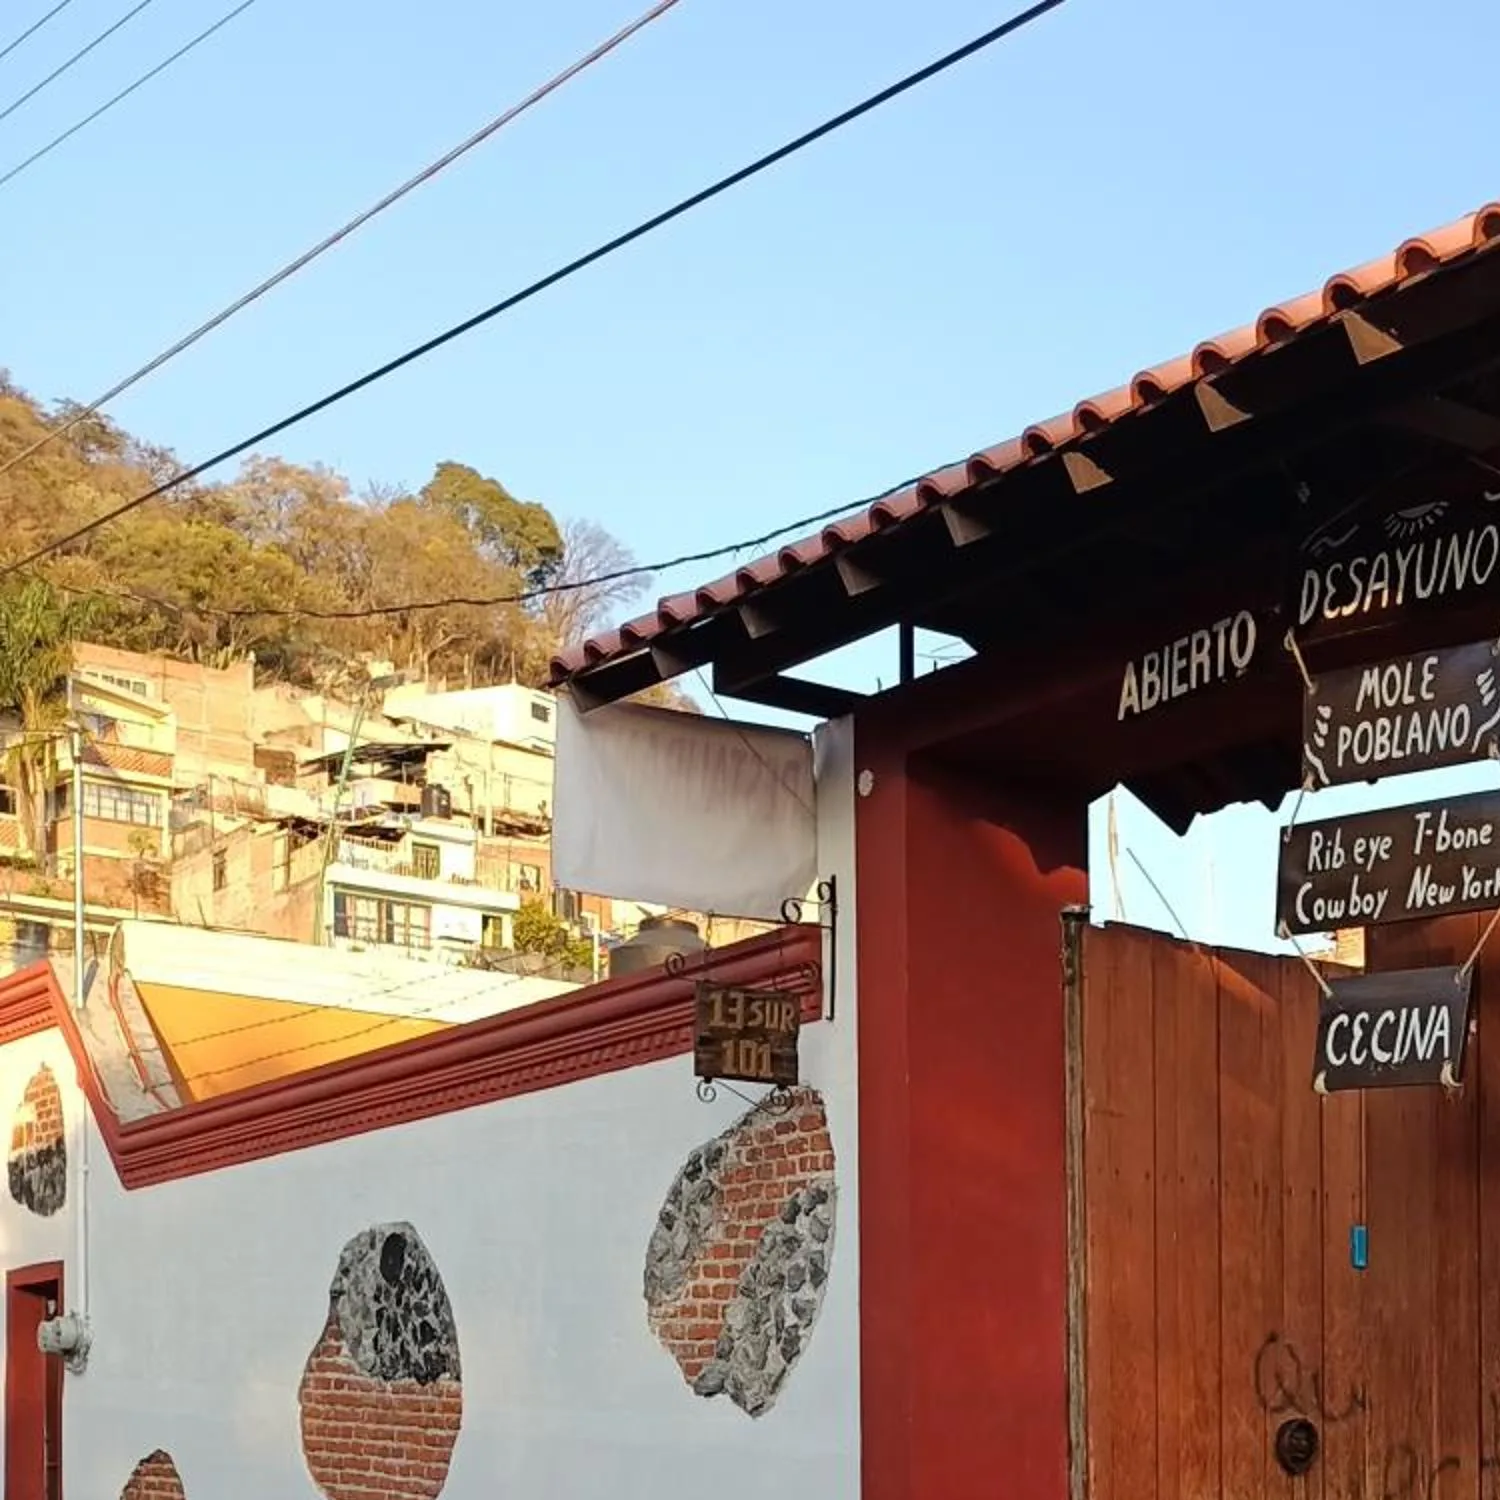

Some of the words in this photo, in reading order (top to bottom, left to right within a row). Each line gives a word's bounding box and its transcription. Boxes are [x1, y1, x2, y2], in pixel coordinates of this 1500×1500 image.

[1118, 610, 1257, 721] ABIERTO
[1355, 655, 1440, 713] MOLE
[1337, 703, 1471, 768] POBLANO
[1307, 827, 1346, 873] Rib
[1353, 834, 1393, 872] eye
[1413, 809, 1494, 855] T-bone
[1295, 874, 1389, 925] Cowboy
[1406, 864, 1455, 910] New
[708, 991, 745, 1029] 13
[747, 1000, 796, 1032] SUR
[1325, 1004, 1450, 1066] CECINA
[721, 1039, 774, 1077] 101
